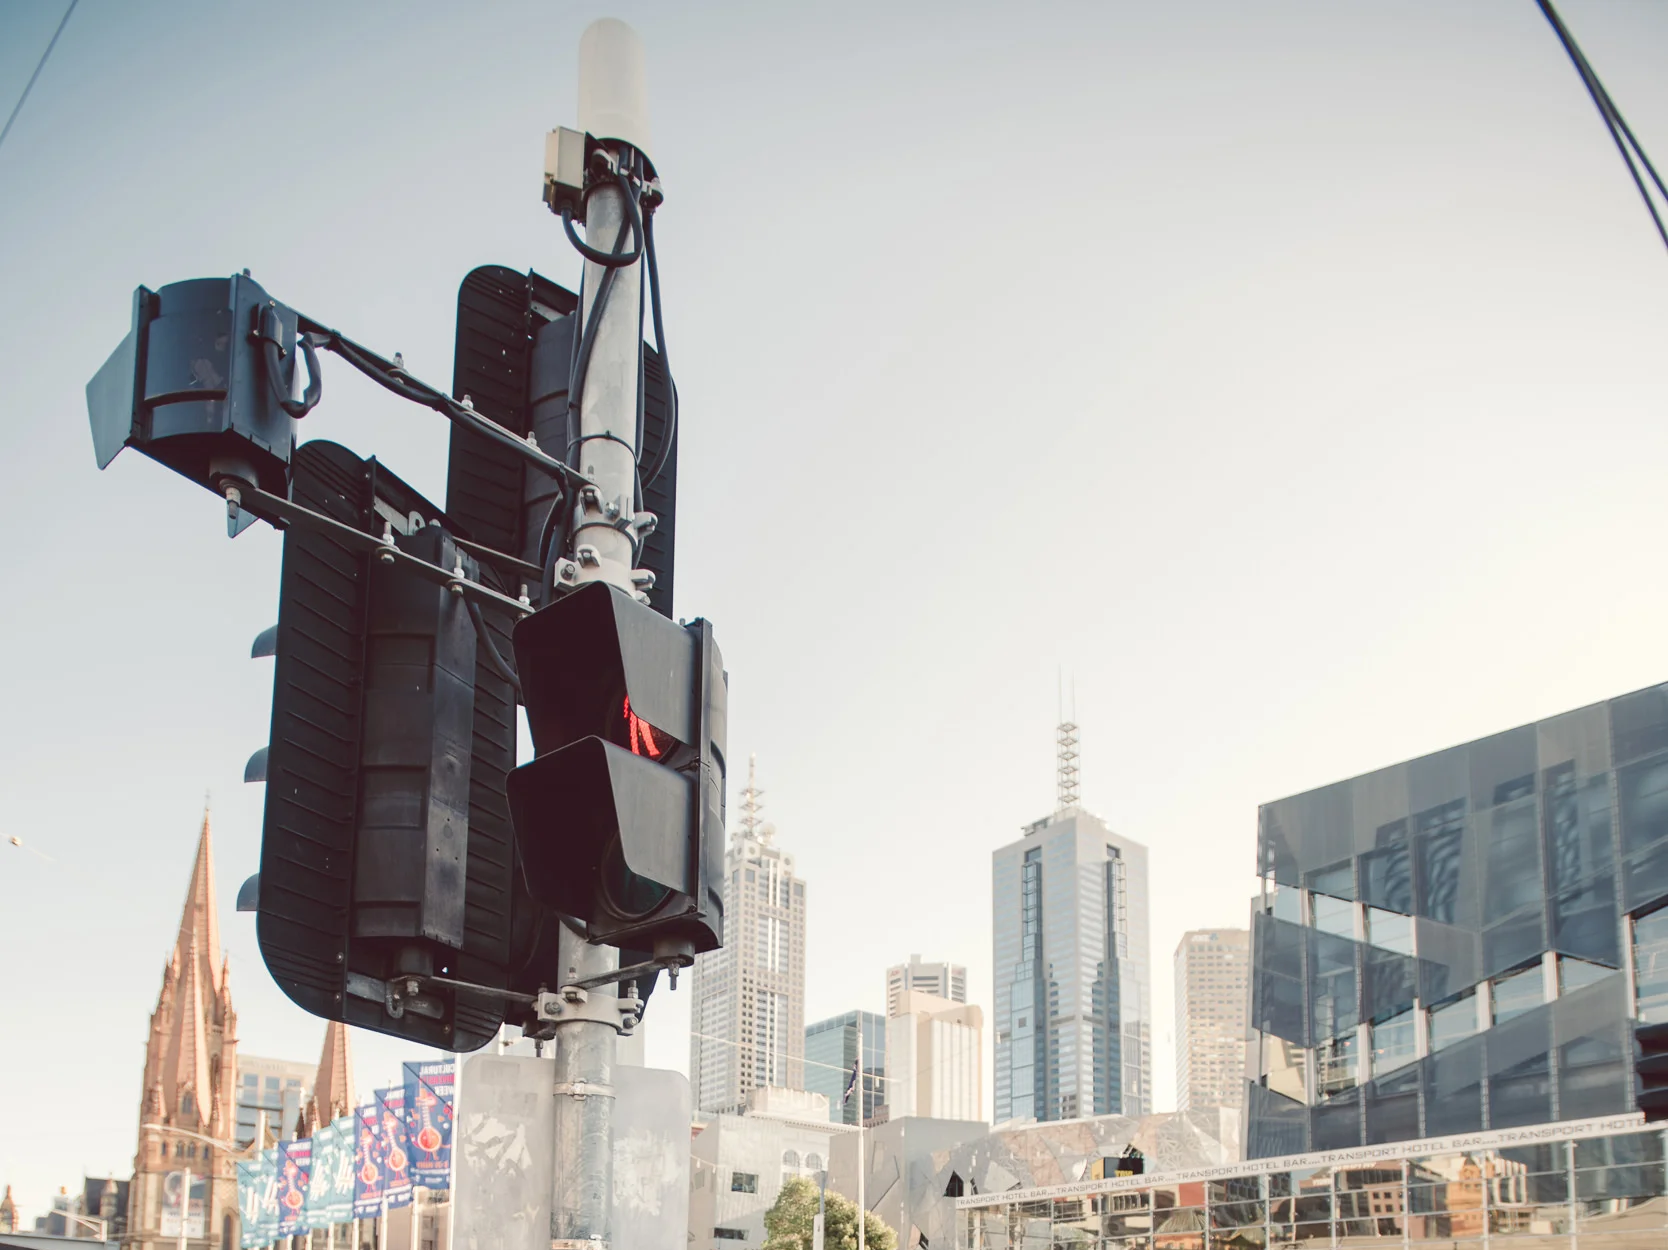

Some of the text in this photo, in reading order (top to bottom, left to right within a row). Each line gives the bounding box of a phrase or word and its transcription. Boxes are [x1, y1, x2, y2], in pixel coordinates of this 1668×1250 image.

[957, 1195, 1000, 1207] TRANSPORT
[1002, 1192, 1028, 1203] HOTEL
[1056, 1180, 1109, 1195] TRANSPORT
[1111, 1178, 1141, 1189] HOTEL
[1176, 1166, 1238, 1179] TRANSPORT
[1243, 1161, 1279, 1172] HOTEL
[1321, 1146, 1398, 1163] TRANSPORT
[1401, 1140, 1448, 1153] HOTEL
[1498, 1123, 1595, 1142] TRANSPORT
[1600, 1117, 1646, 1131] HOTE
